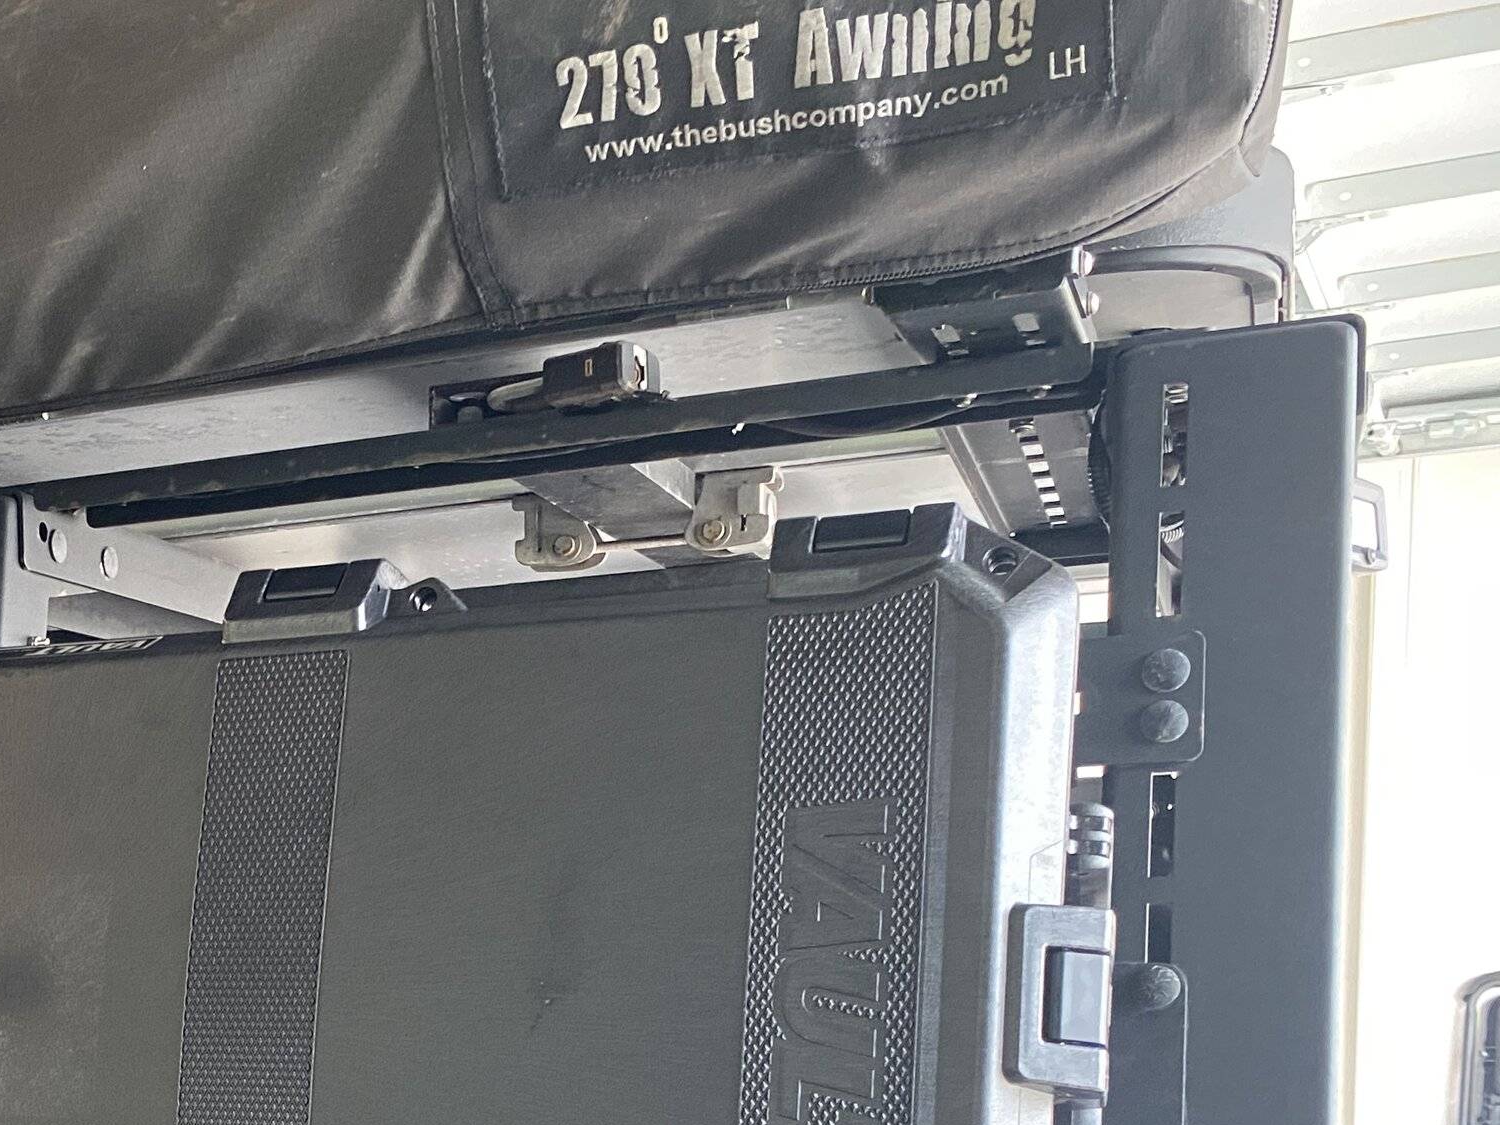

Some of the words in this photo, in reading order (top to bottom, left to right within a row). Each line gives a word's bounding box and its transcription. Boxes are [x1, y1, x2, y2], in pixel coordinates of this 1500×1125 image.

[683, 20, 759, 108] XT
[793, 0, 1036, 88] Awning
[1049, 44, 1087, 80] LH
[584, 73, 1010, 163] www.thebushcompany.com
